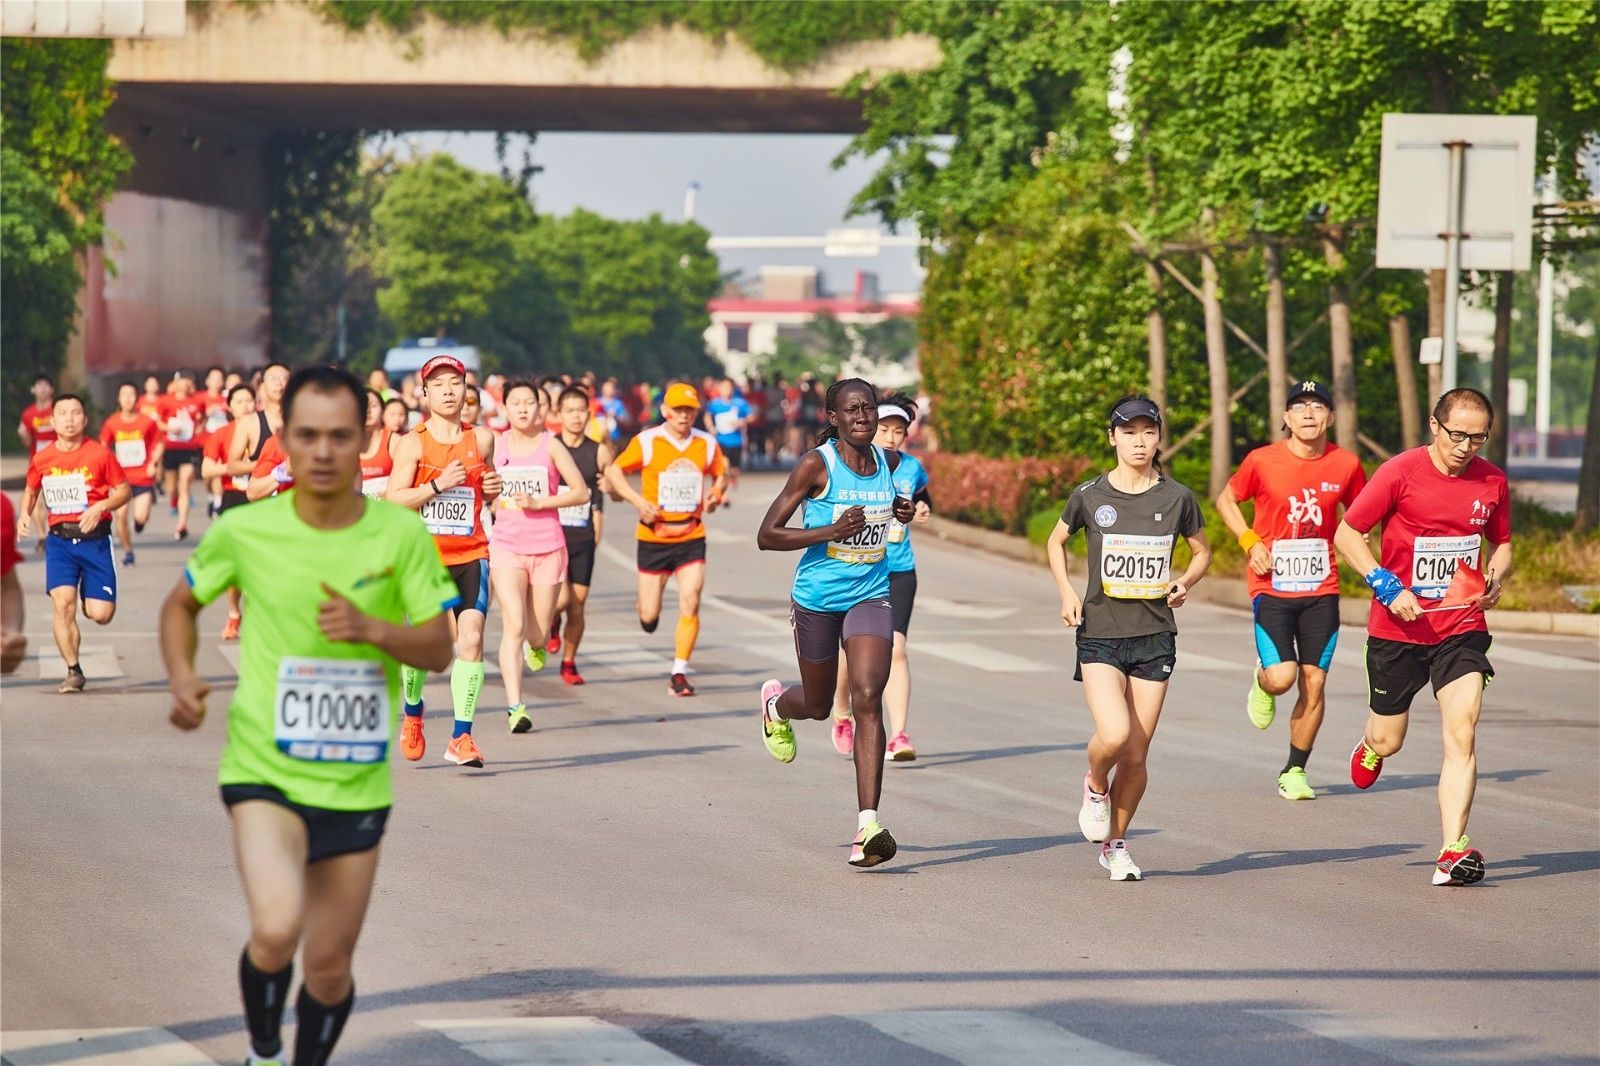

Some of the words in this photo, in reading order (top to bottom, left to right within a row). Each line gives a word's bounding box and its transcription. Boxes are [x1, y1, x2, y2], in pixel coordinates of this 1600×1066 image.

[46, 487, 79, 502] C10042
[420, 501, 467, 521] C10692
[1287, 488, 1323, 527] 战
[833, 522, 887, 547] 0267
[1103, 554, 1165, 579] C20157
[1274, 556, 1323, 576] C10764
[281, 689, 381, 731] C10008
